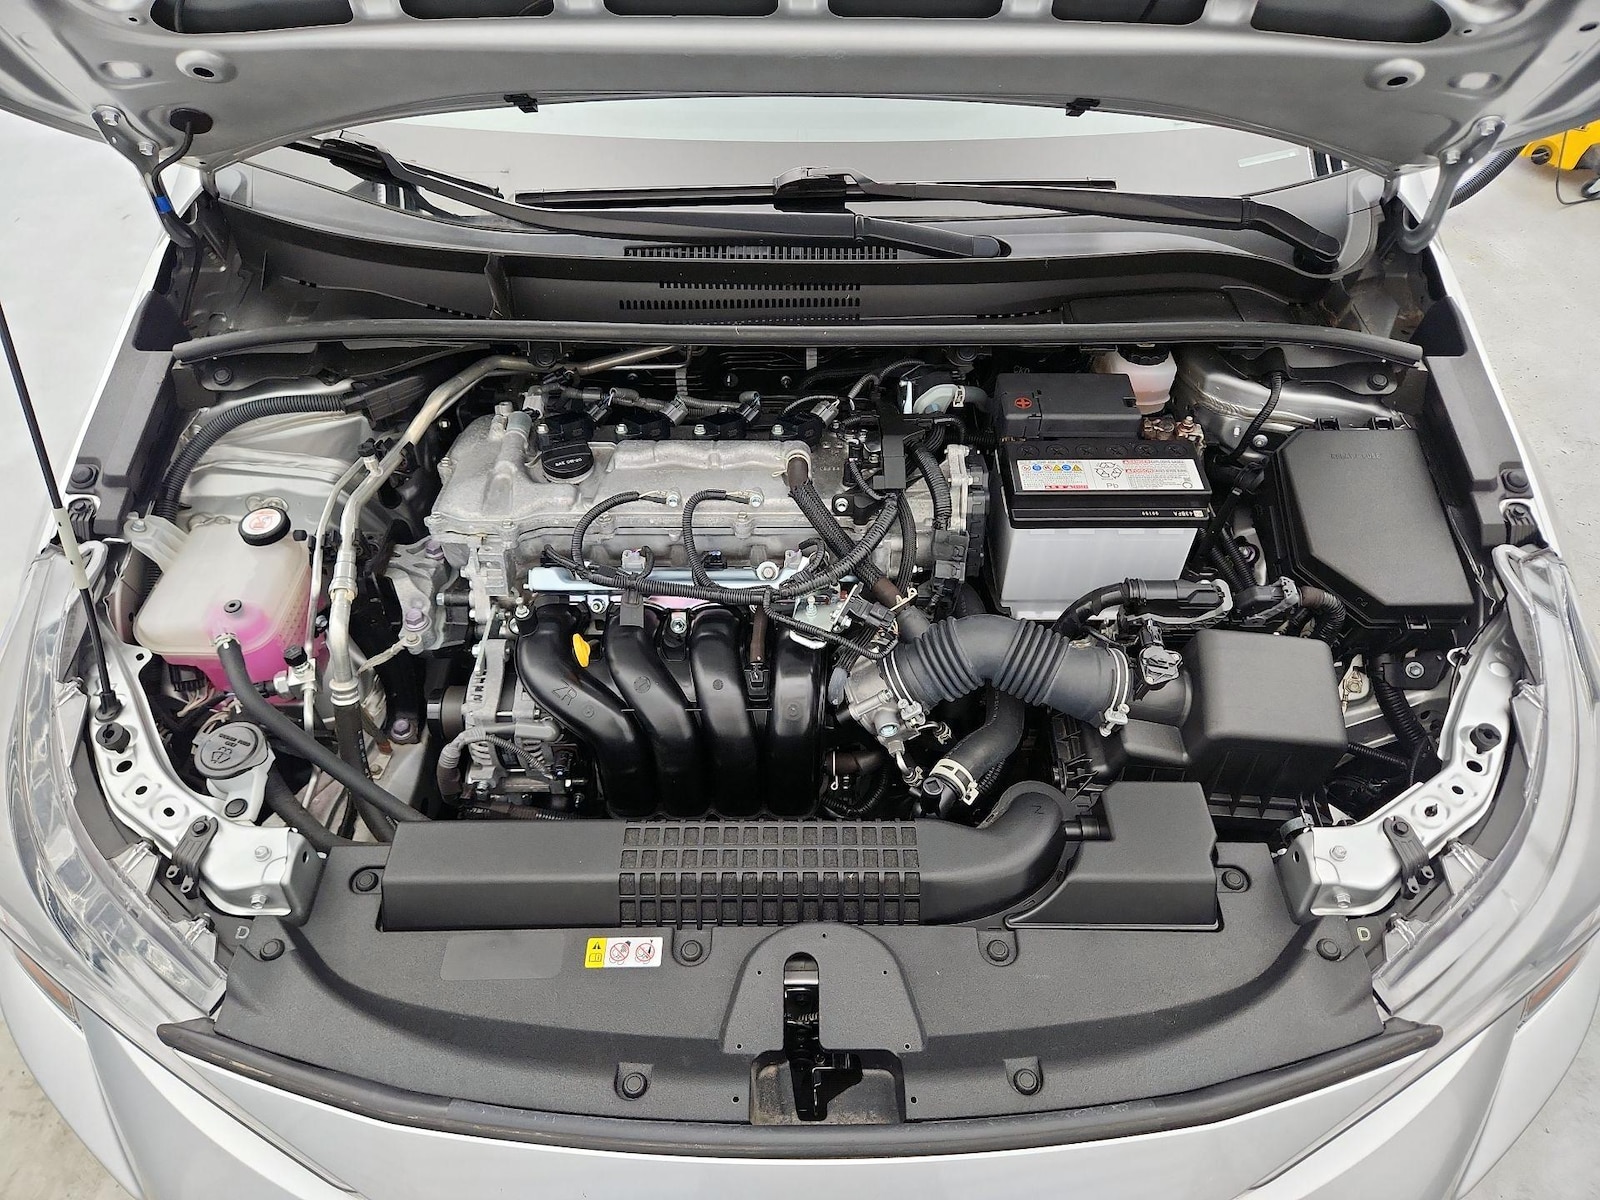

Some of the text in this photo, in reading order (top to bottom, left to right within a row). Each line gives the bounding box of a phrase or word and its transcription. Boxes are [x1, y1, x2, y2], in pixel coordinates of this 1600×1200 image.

[551, 678, 578, 706] ZR
[235, 925, 250, 940] D
[1356, 926, 1371, 941] D
